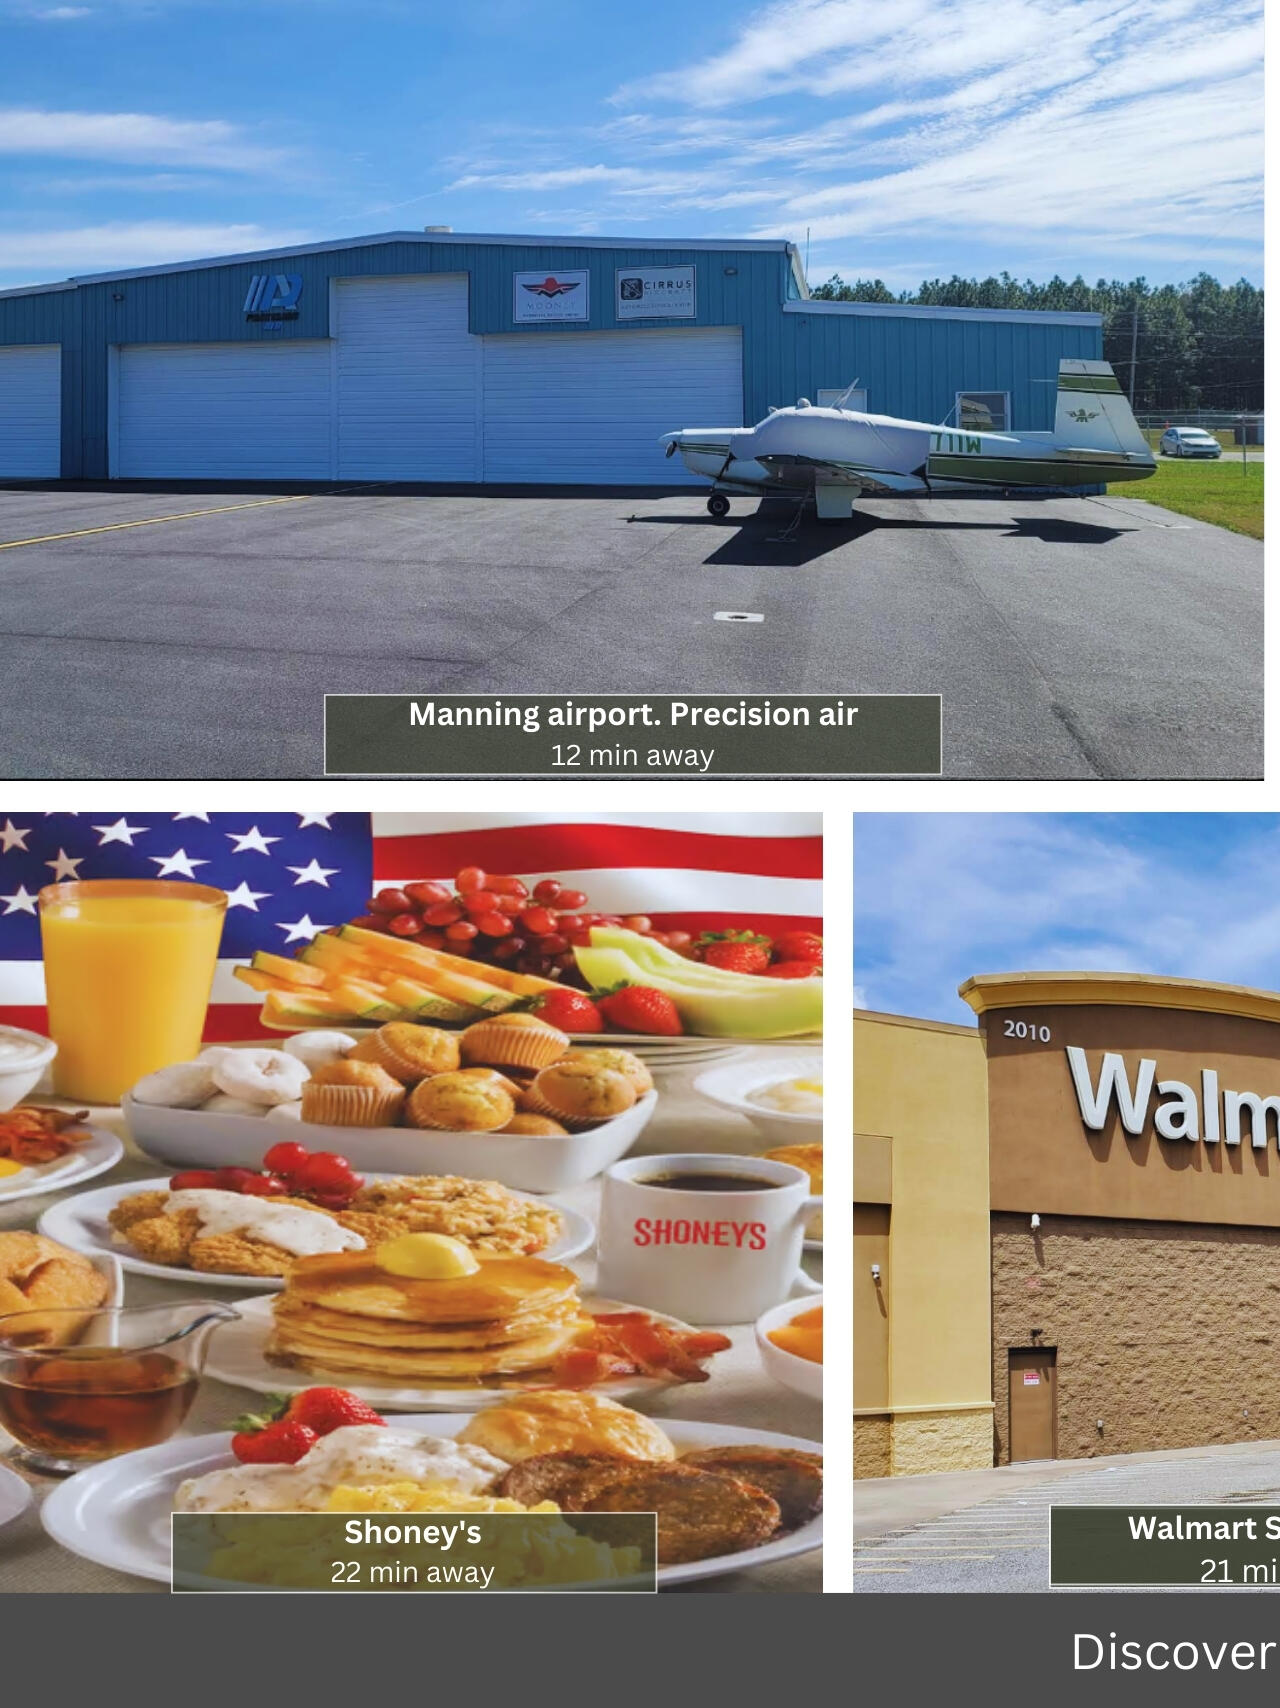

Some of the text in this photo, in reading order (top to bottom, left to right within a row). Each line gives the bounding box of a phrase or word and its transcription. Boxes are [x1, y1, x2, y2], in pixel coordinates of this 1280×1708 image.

[643, 280, 693, 290] CIRRUS
[929, 431, 981, 454] 711W
[1003, 1019, 1051, 1043] 2010
[633, 1217, 767, 1250] SHONEYS
